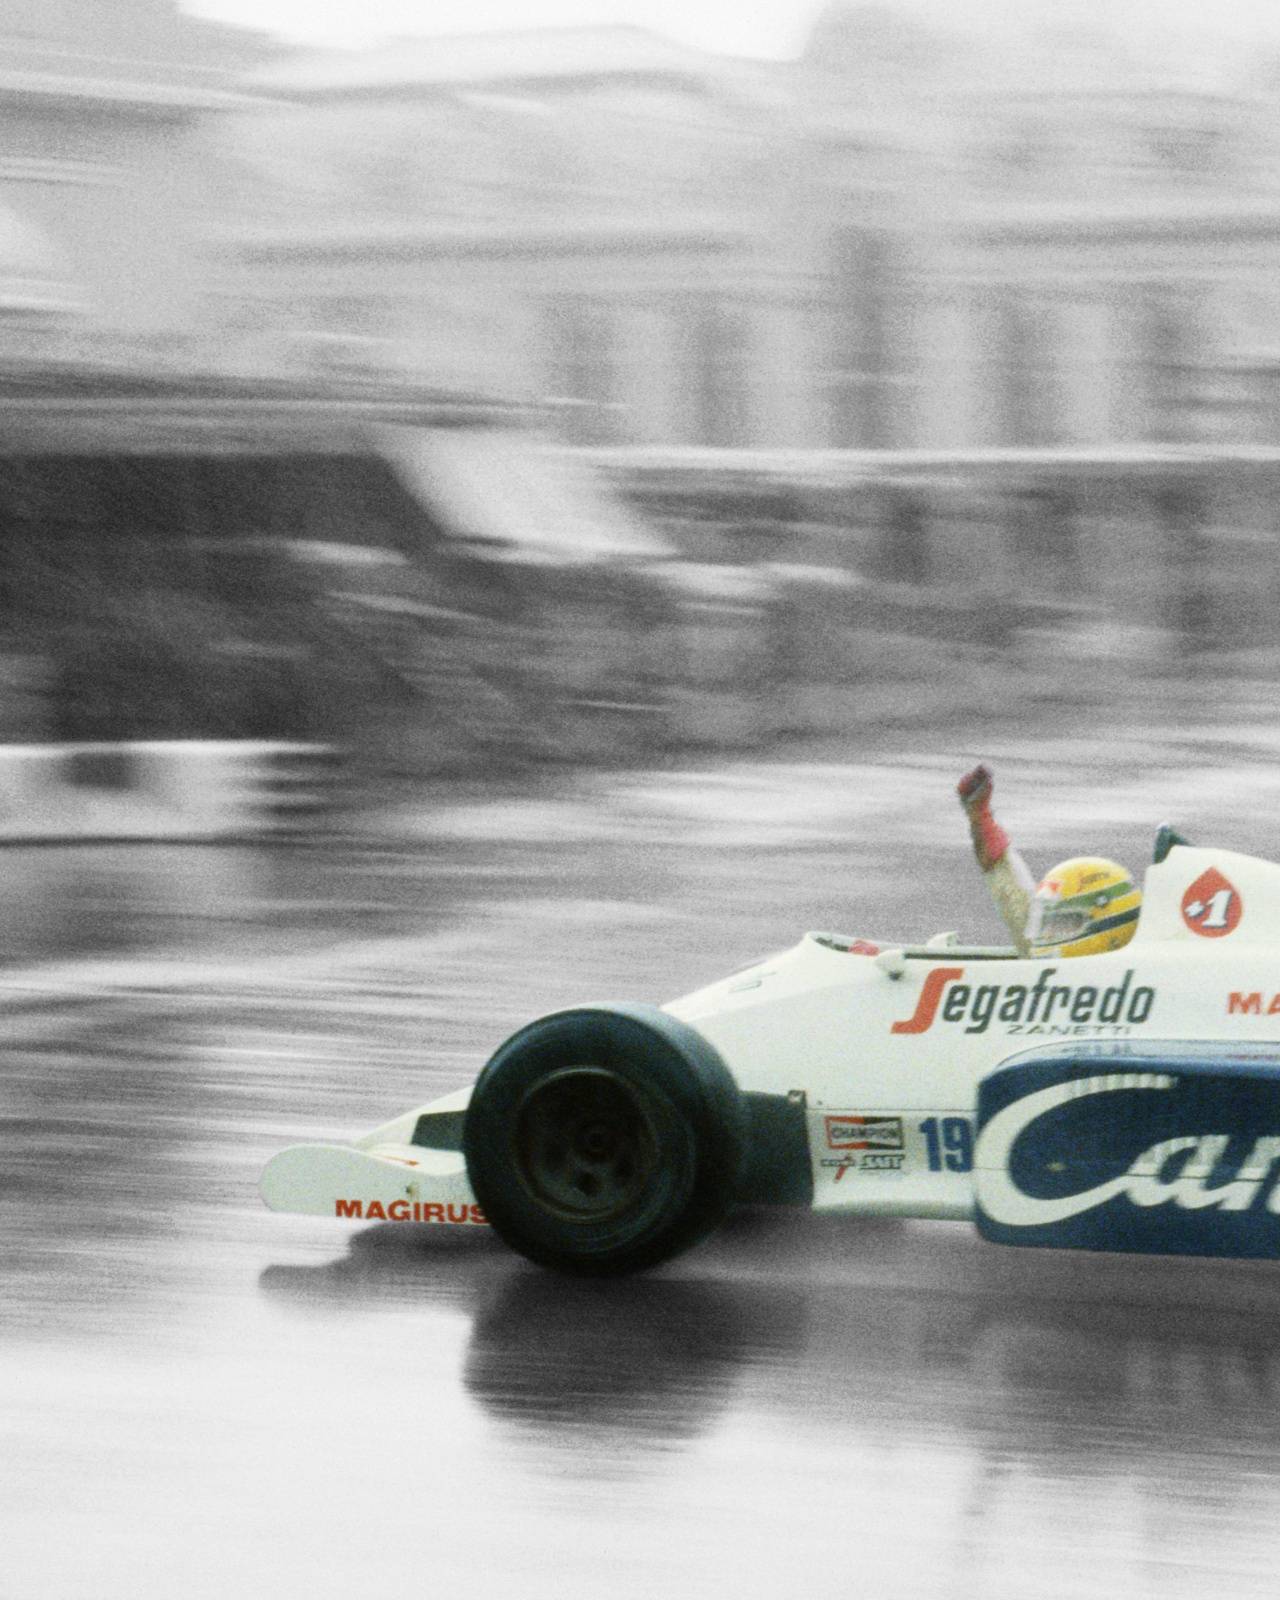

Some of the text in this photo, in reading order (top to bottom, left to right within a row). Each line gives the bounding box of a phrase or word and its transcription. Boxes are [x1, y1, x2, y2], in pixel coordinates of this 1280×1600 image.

[890, 967, 1156, 1035] Segafredo
[1007, 1024, 1132, 1036] ZANETTI
[919, 1117, 974, 1173] 19
